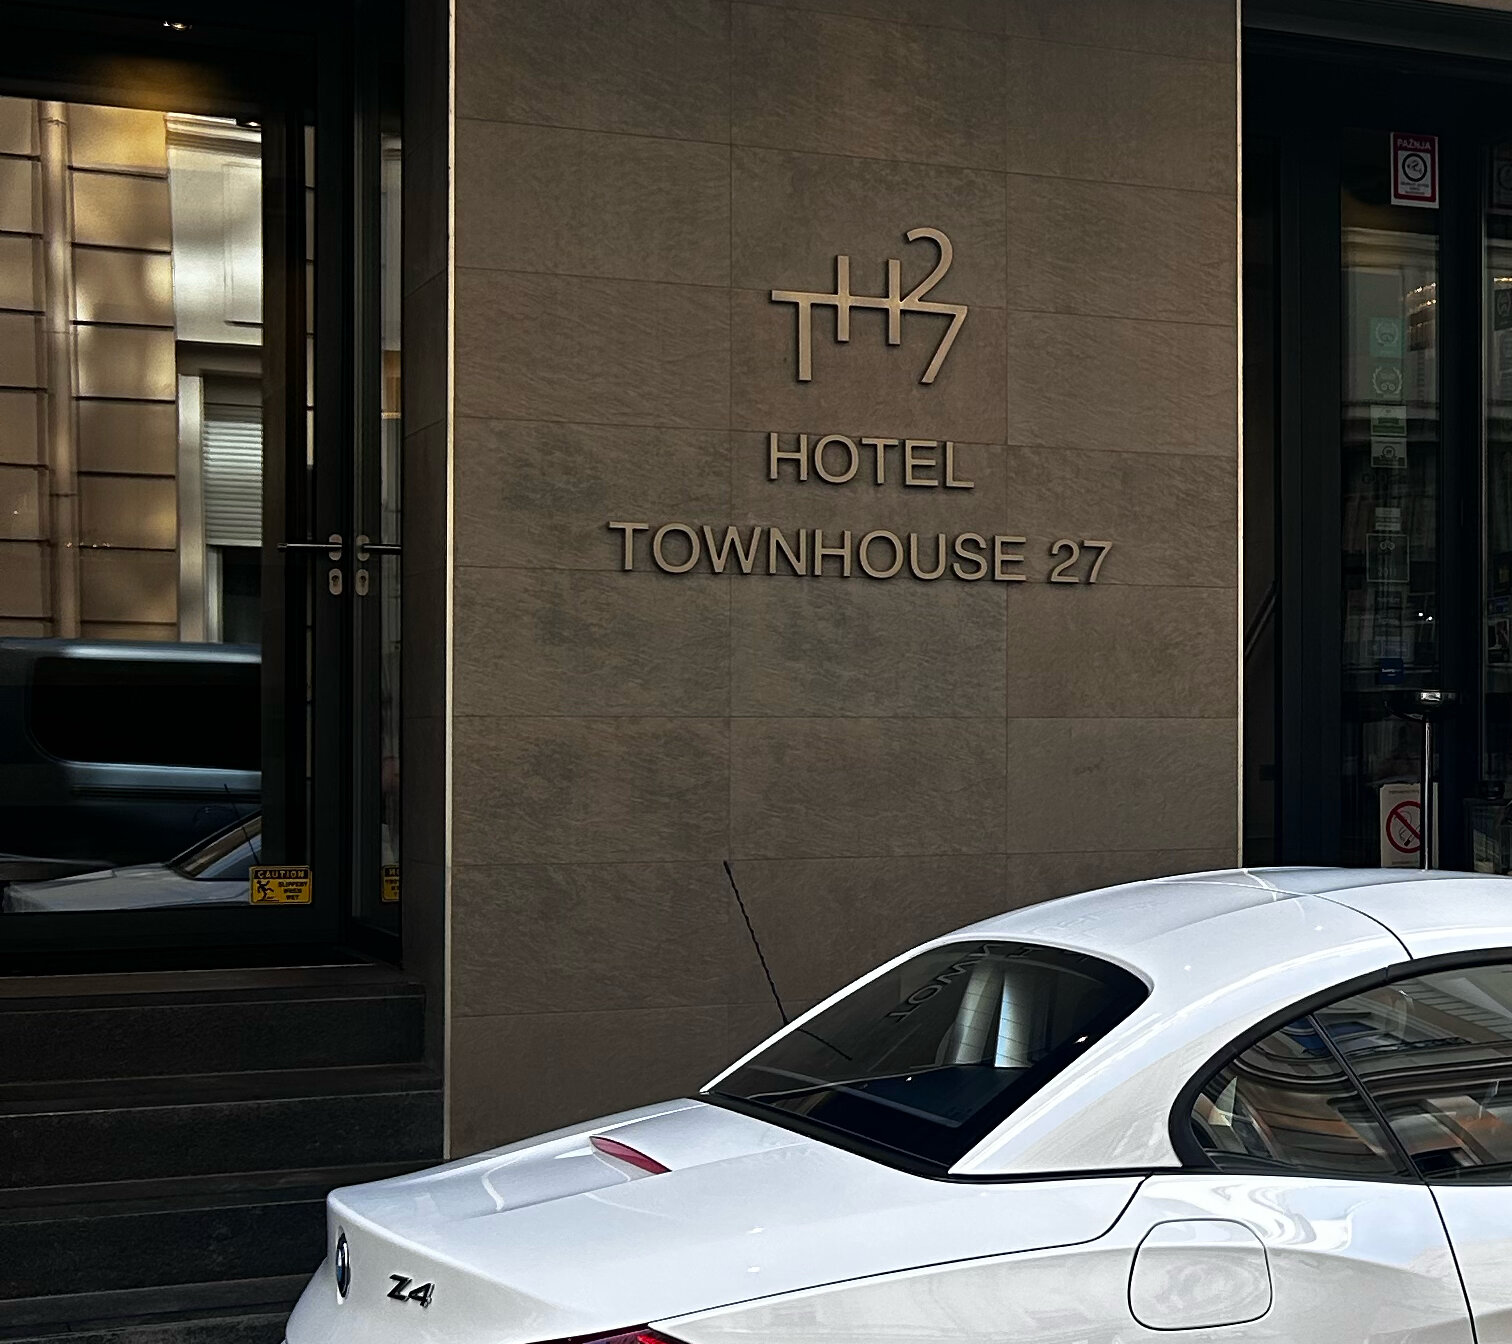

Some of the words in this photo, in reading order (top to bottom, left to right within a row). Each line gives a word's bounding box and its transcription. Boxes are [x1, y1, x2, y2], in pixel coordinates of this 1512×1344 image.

[1397, 137, 1432, 150] PAŽNJA
[769, 432, 975, 490] HOTEL
[608, 521, 1028, 582] TOWNHOUSE
[1050, 540, 1114, 585] 27
[257, 869, 305, 879] CAUTION
[387, 1273, 436, 1308] Z4
